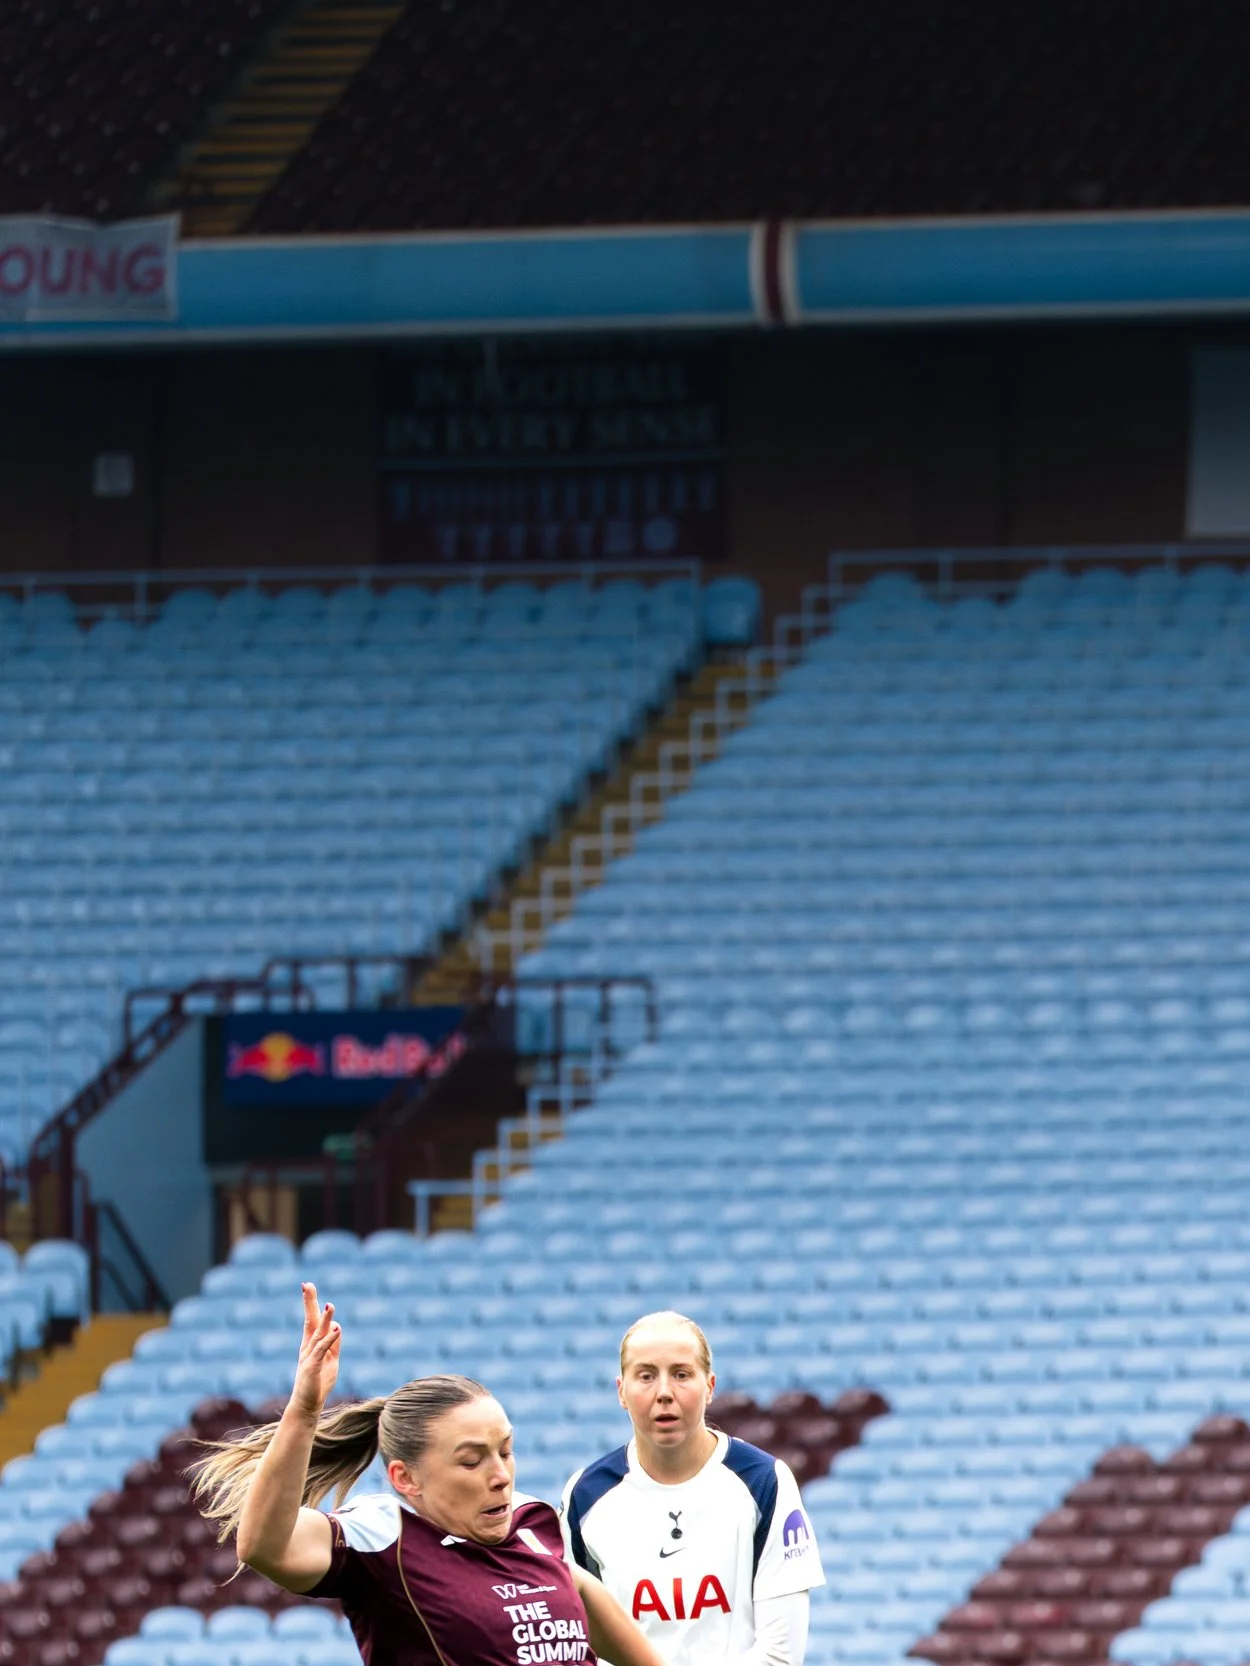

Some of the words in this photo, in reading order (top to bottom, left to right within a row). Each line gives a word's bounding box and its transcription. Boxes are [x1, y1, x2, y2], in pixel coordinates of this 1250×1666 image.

[0, 244, 165, 296] OUNG
[632, 1574, 732, 1622] AIA
[503, 1601, 552, 1623] THE
[512, 1620, 586, 1644] GLOBAL
[516, 1641, 589, 1665] SUMMIT
